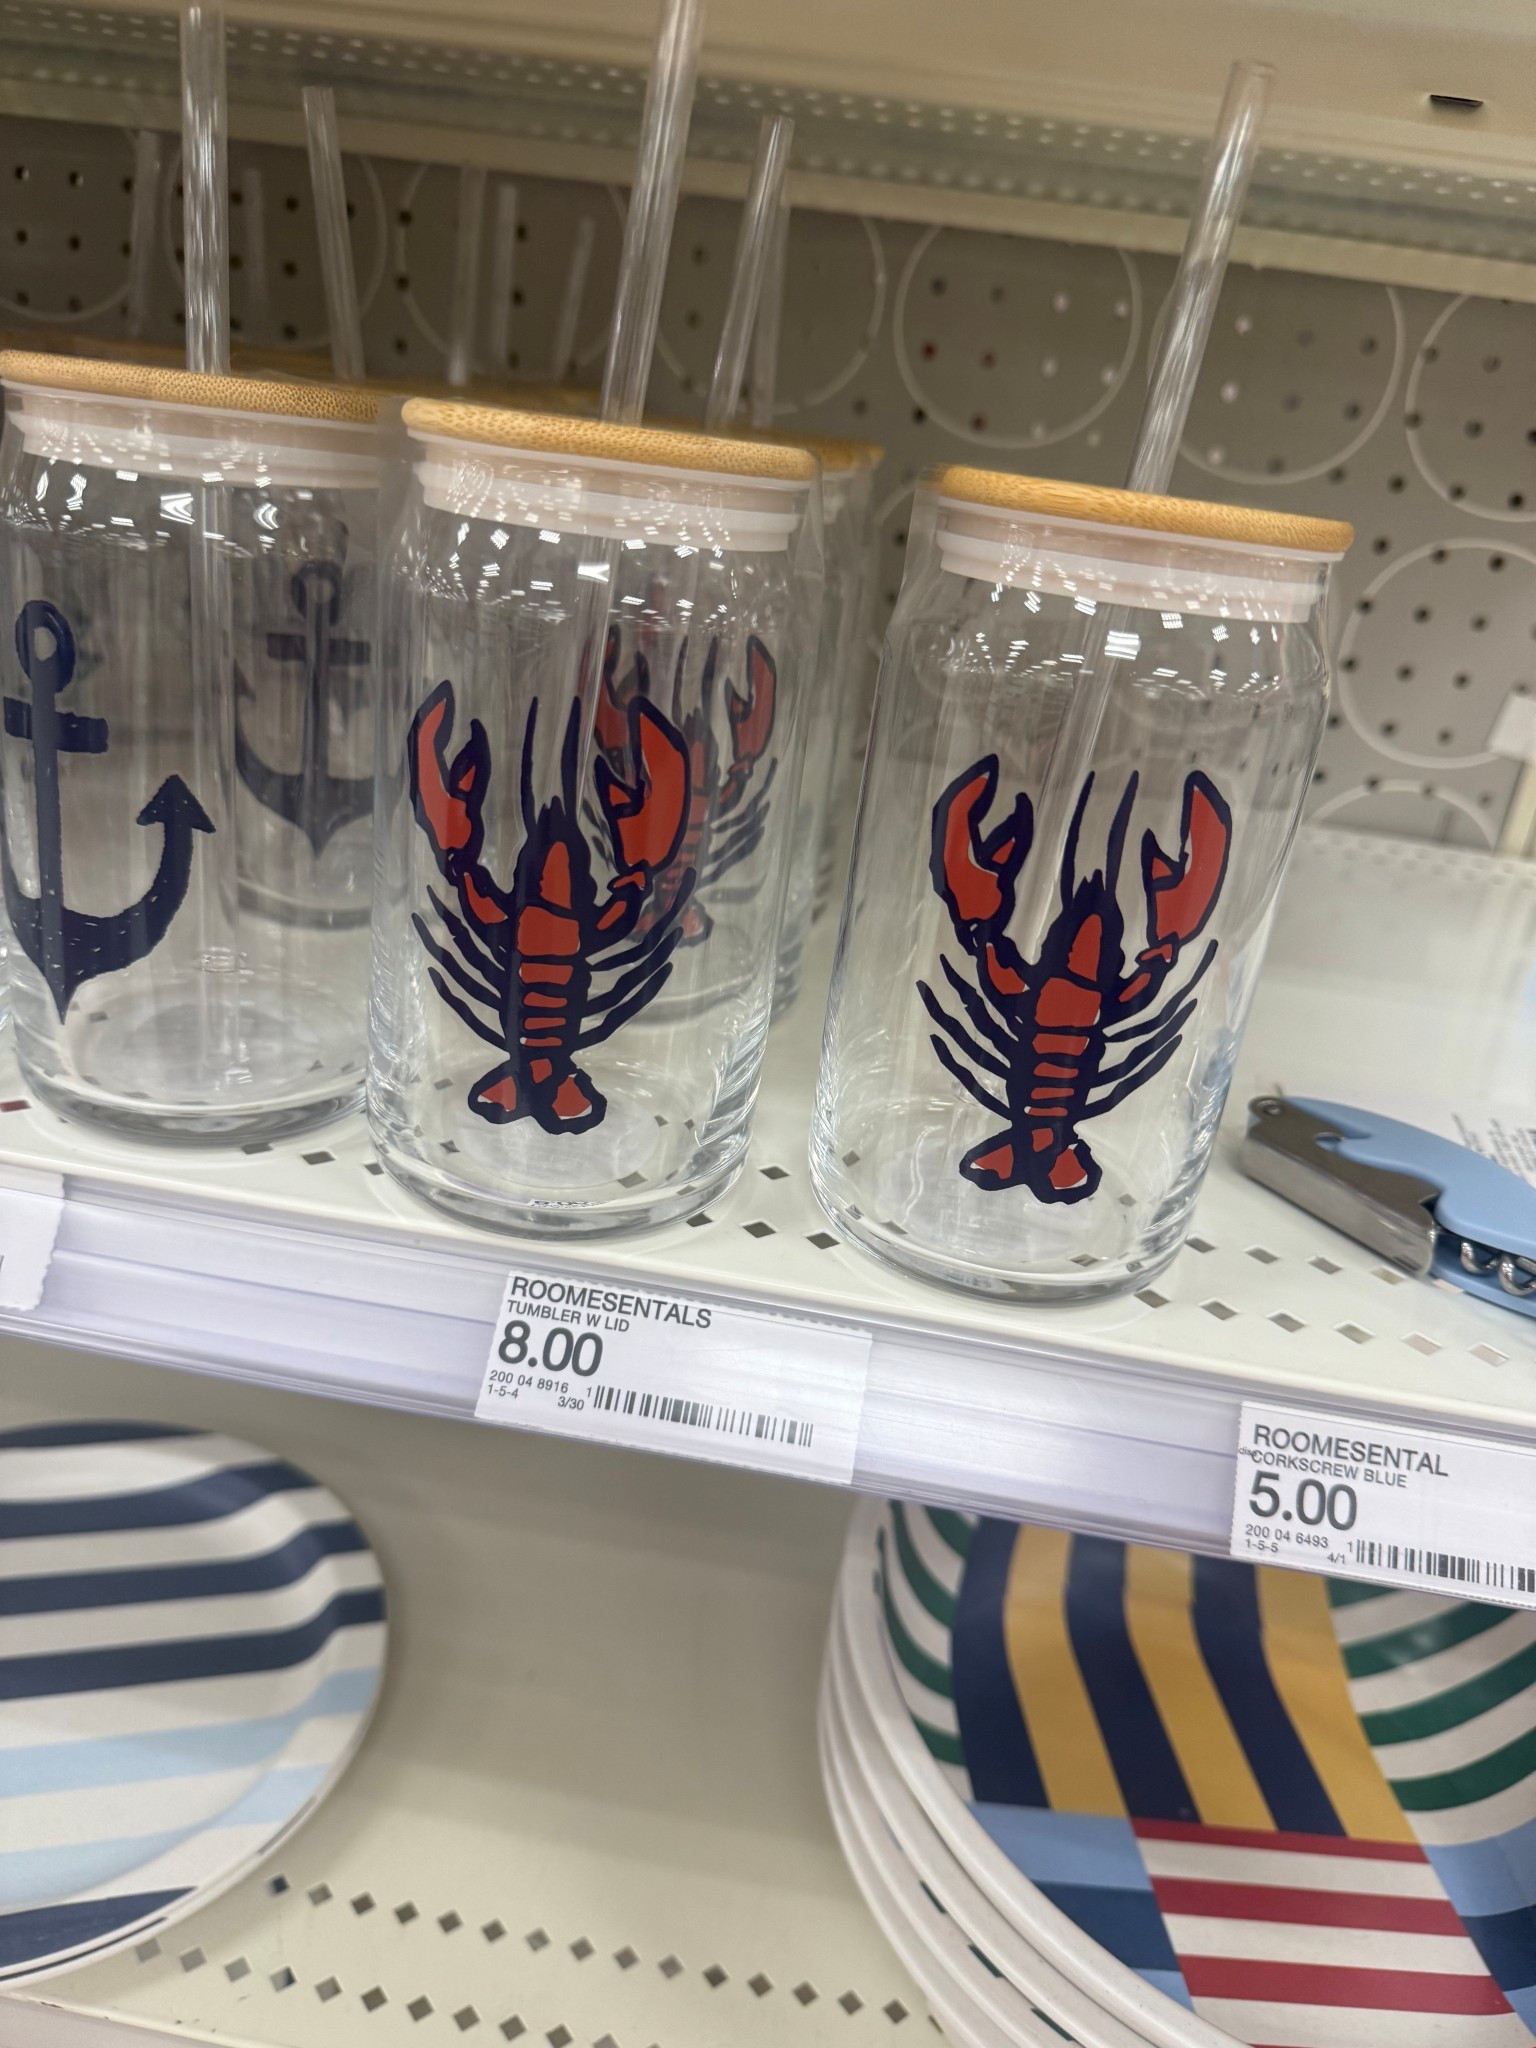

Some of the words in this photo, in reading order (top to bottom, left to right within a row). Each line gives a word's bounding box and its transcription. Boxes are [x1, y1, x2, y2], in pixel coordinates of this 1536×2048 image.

[508, 1300, 581, 1324] TUMBLER
[586, 1313, 602, 1327] W
[604, 1316, 630, 1332] LID
[510, 1276, 712, 1328] ROOMESENTALS
[498, 1320, 603, 1376] 8.00
[487, 1384, 519, 1399] 1-5-4
[489, 1370, 514, 1384] 200
[517, 1374, 533, 1387] 04
[537, 1378, 569, 1394] 8916
[558, 1396, 585, 1411] 3/30
[1254, 1424, 1449, 1476] ROOMESENTAL
[1251, 1450, 1358, 1479] CORKSCREW
[1364, 1469, 1407, 1488] BLUE
[1249, 1470, 1358, 1530] 5.00
[1245, 1524, 1270, 1539] 200
[1274, 1528, 1291, 1542] 04
[1295, 1532, 1329, 1548] 6493
[1245, 1539, 1279, 1553] 1-5-5
[1327, 1552, 1346, 1565] 4/1
